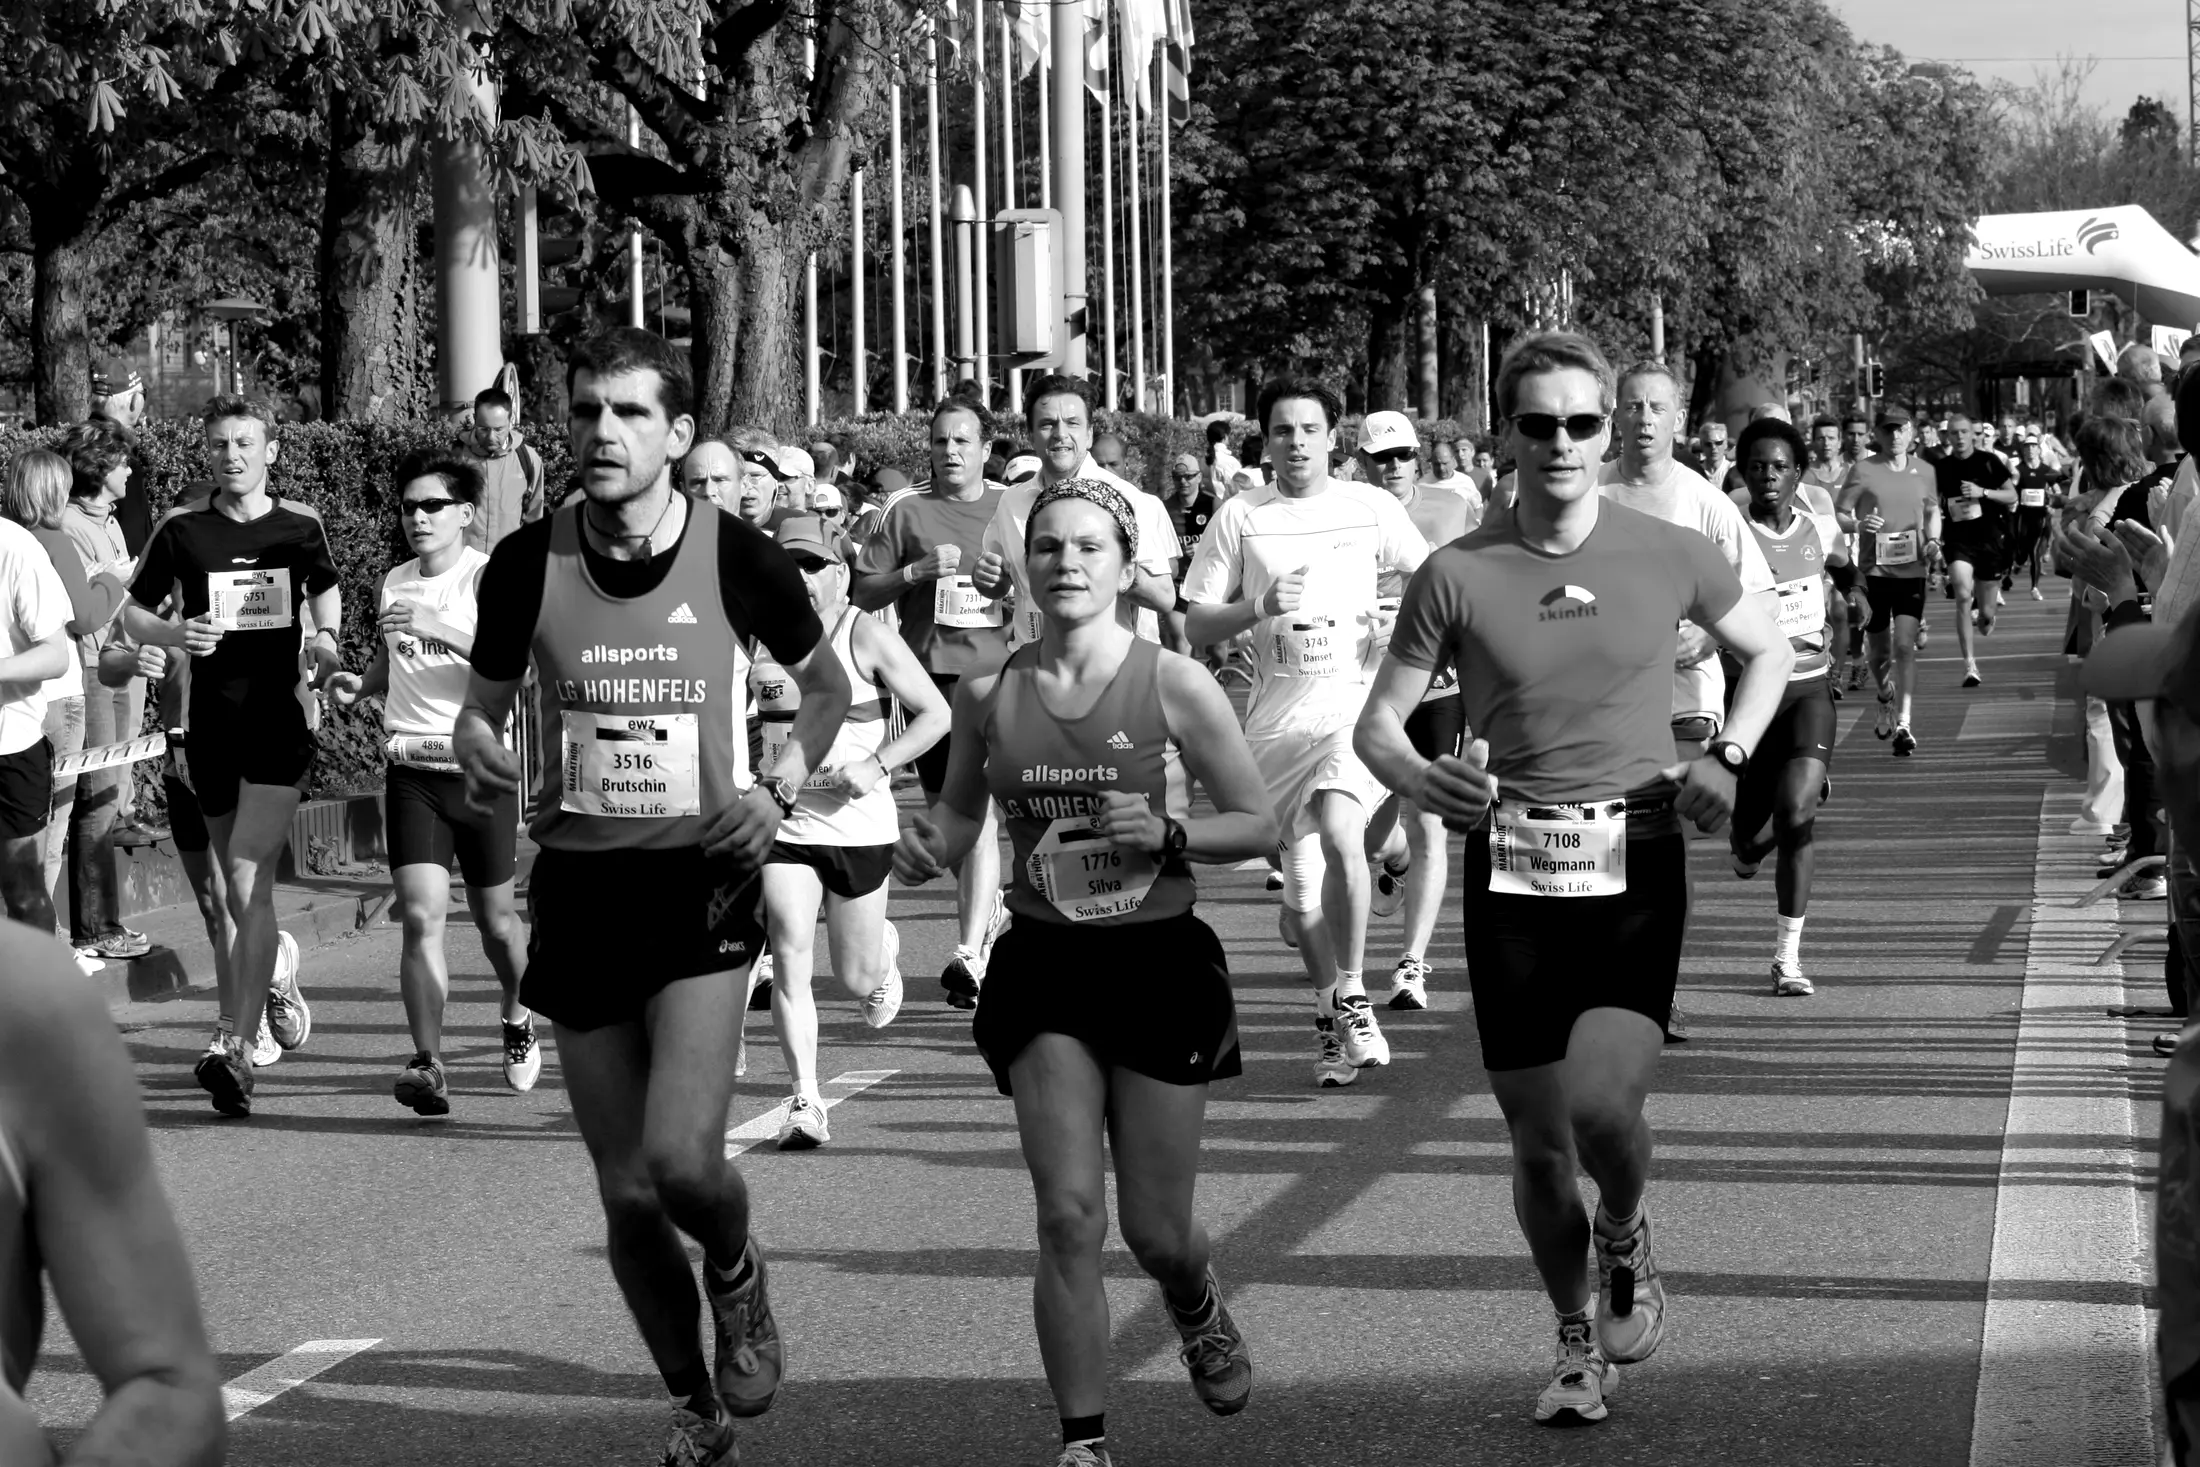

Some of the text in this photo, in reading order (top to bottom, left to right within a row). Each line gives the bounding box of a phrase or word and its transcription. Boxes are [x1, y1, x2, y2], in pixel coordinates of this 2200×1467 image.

[243, 592, 265, 601] 6751
[241, 606, 270, 616] Strubel
[1539, 604, 1598, 622] skinfit
[1785, 600, 1802, 612] 1597
[236, 619, 274, 629] Swiss Life
[667, 616, 698, 624] adidas
[1304, 637, 1328, 649] 3743
[581, 644, 679, 665] allsports
[1303, 653, 1333, 663] Danset
[1298, 668, 1321, 676] Swiss
[556, 679, 706, 703] LG HOHENFELS
[628, 720, 656, 730] ewz
[421, 740, 444, 751] 4896
[569, 741, 578, 792] MARATHON
[613, 753, 653, 769] 3516
[1021, 764, 1119, 785] allsports
[602, 778, 667, 793] Brutschin
[813, 779, 830, 788] Life
[601, 802, 667, 815] Swiss Life
[1543, 833, 1581, 848] 7108
[1497, 825, 1507, 871] MARATHON
[1081, 850, 1121, 872] 1776
[1530, 856, 1595, 875] Wegmann
[1088, 879, 1122, 895] Silva
[1531, 880, 1593, 893] Swiss Life
[1075, 896, 1141, 918] Swiss Life
